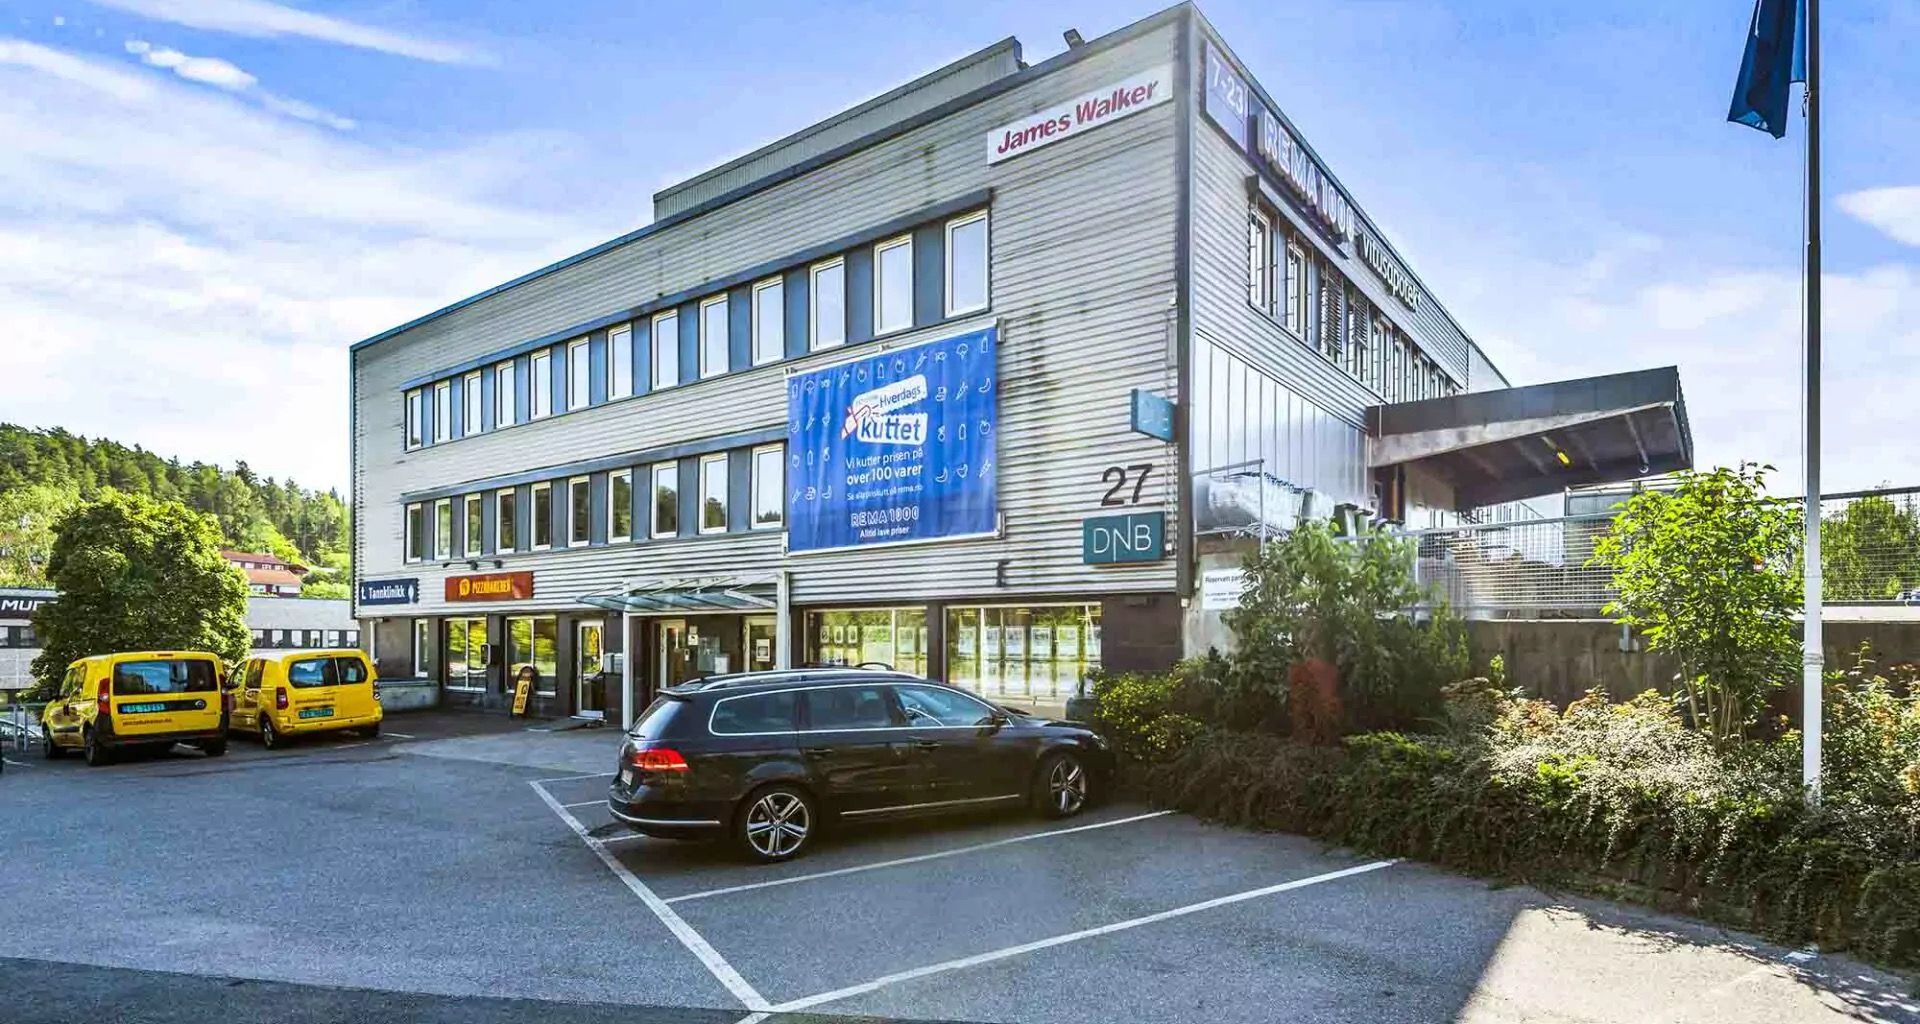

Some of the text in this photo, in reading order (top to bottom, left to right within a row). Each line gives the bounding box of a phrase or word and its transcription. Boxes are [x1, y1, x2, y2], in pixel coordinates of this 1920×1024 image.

[1212, 57, 1244, 115] 7-23
[997, 80, 1160, 154] James Walker
[1264, 110, 1355, 242] REMA 1000
[879, 385, 921, 408] Hverdags
[861, 416, 921, 441] kuttet
[846, 447, 924, 469] Vi kutter prisen på
[846, 464, 923, 486] over 100 varer
[1101, 463, 1153, 507] 27
[851, 505, 920, 528] REMA 1000
[860, 525, 910, 538] Alltid lave priser
[1093, 515, 1152, 563] DNB
[368, 584, 406, 600] Tannklinikk
